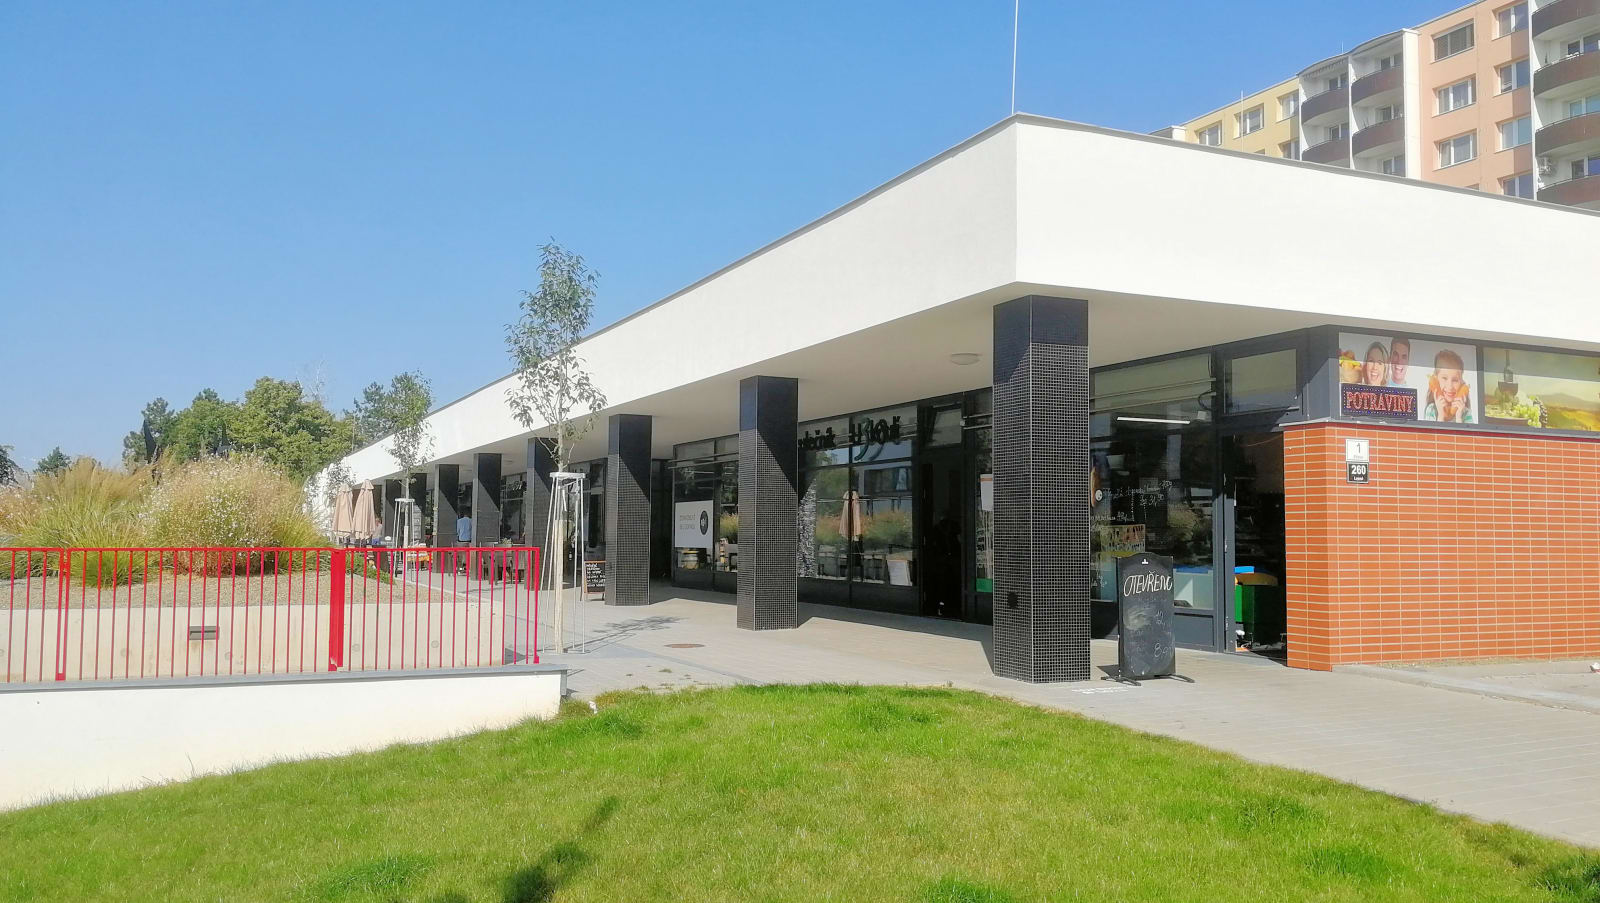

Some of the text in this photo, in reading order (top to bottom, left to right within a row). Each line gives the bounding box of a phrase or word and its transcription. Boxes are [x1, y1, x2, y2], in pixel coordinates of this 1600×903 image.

[1345, 391, 1414, 413] POTRAVINY
[1356, 442, 1361, 454] 1
[1351, 464, 1367, 475] 260
[1123, 570, 1173, 597] OTEVŘENO
